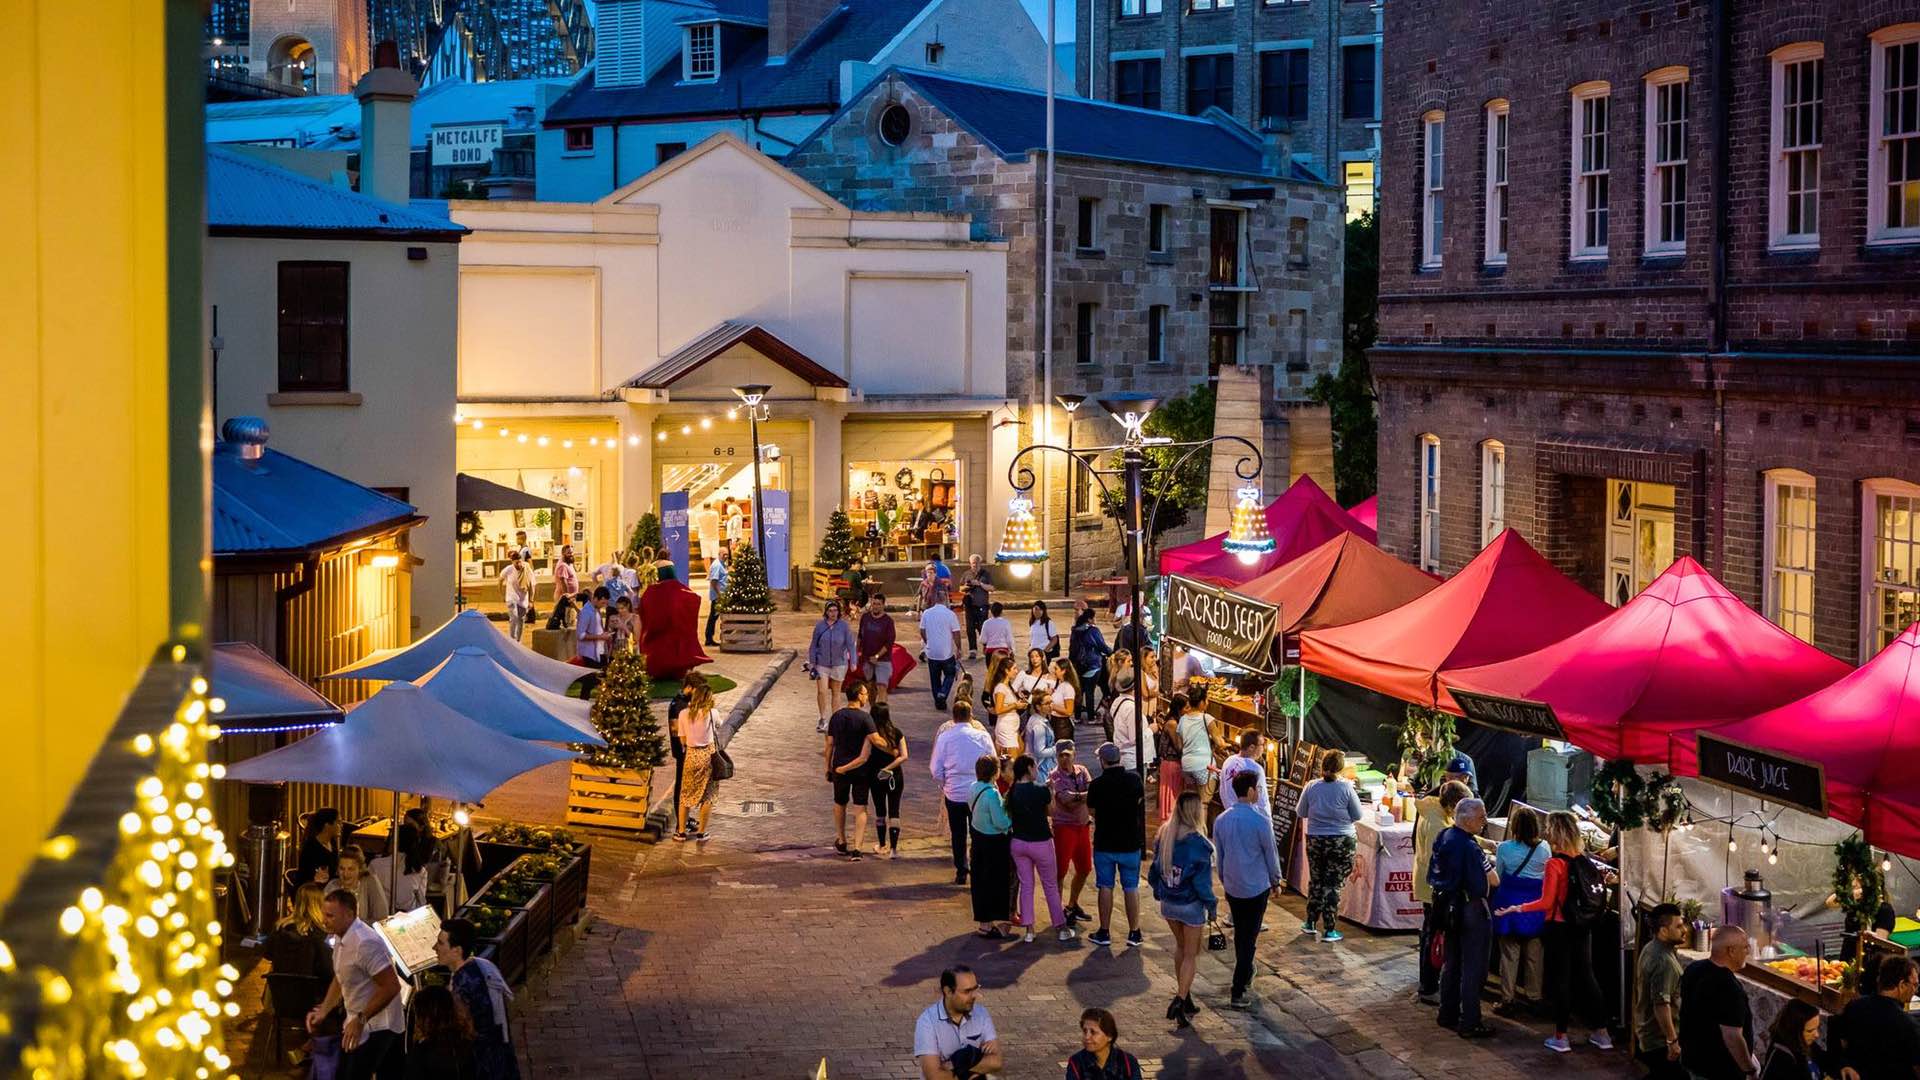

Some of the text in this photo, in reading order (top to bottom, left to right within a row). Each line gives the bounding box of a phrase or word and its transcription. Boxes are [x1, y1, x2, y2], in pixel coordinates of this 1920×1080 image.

[436, 128, 498, 145] METCALFE
[452, 147, 481, 163] BOND
[713, 447, 735, 456] 6-8
[1176, 585, 1264, 642] SACRED SEED
[1206, 630, 1223, 645] FOOD
[1726, 751, 1790, 791] DARE JUICE
